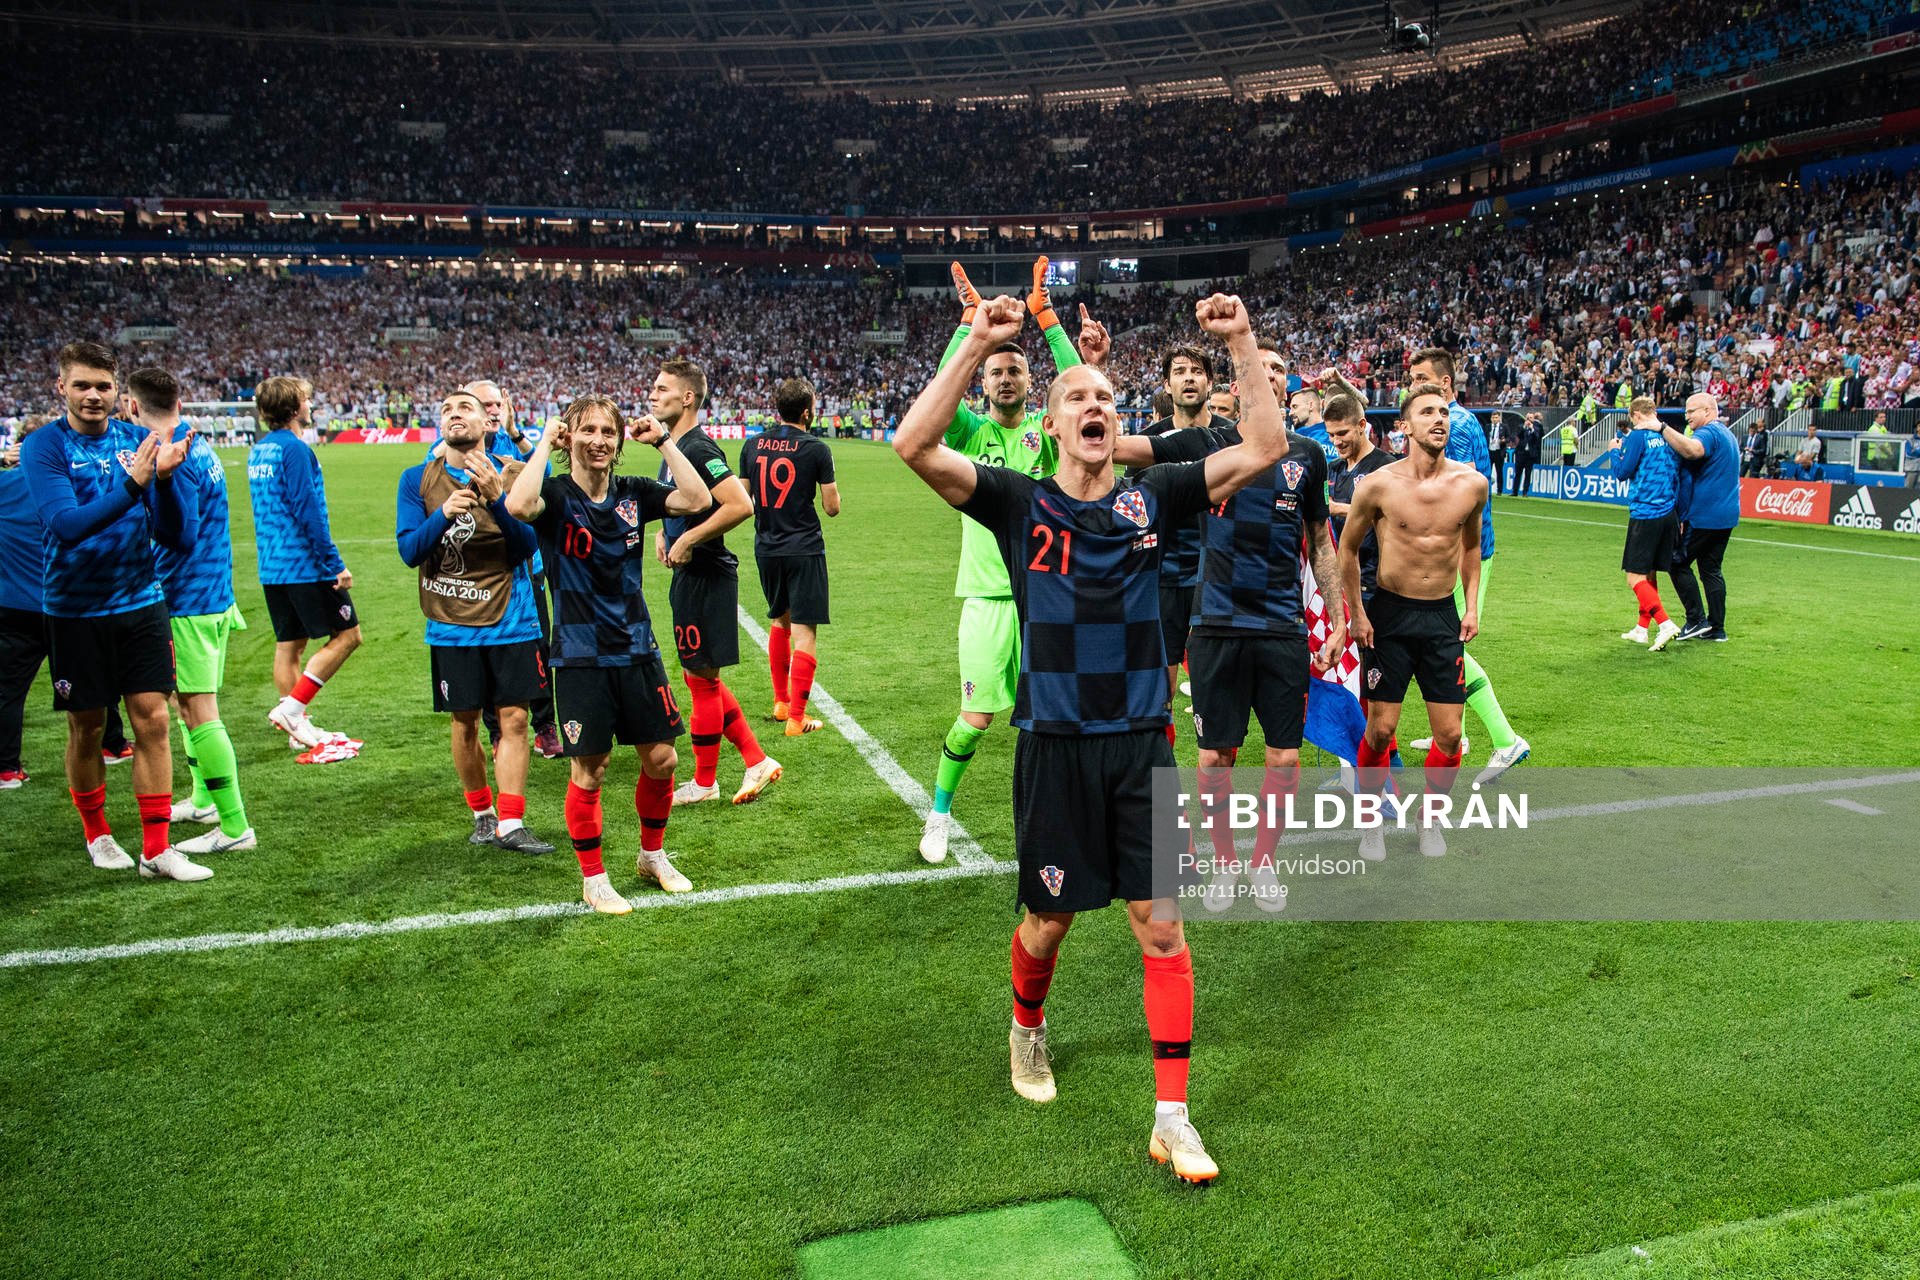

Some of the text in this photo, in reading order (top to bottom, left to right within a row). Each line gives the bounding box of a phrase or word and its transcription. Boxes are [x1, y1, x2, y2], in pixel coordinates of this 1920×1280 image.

[360, 428, 408, 443] Bud
[757, 438, 799, 452] BADELJ
[98, 458, 111, 475] 15
[756, 456, 796, 509] 19
[1755, 486, 1818, 516] Coca-Cola
[1834, 513, 1883, 530] adidas
[564, 523, 593, 559] 10
[1028, 524, 1072, 575] 21
[422, 577, 492, 601] RUSSIA 2018
[461, 579, 476, 587] CUP
[675, 625, 701, 650] 20
